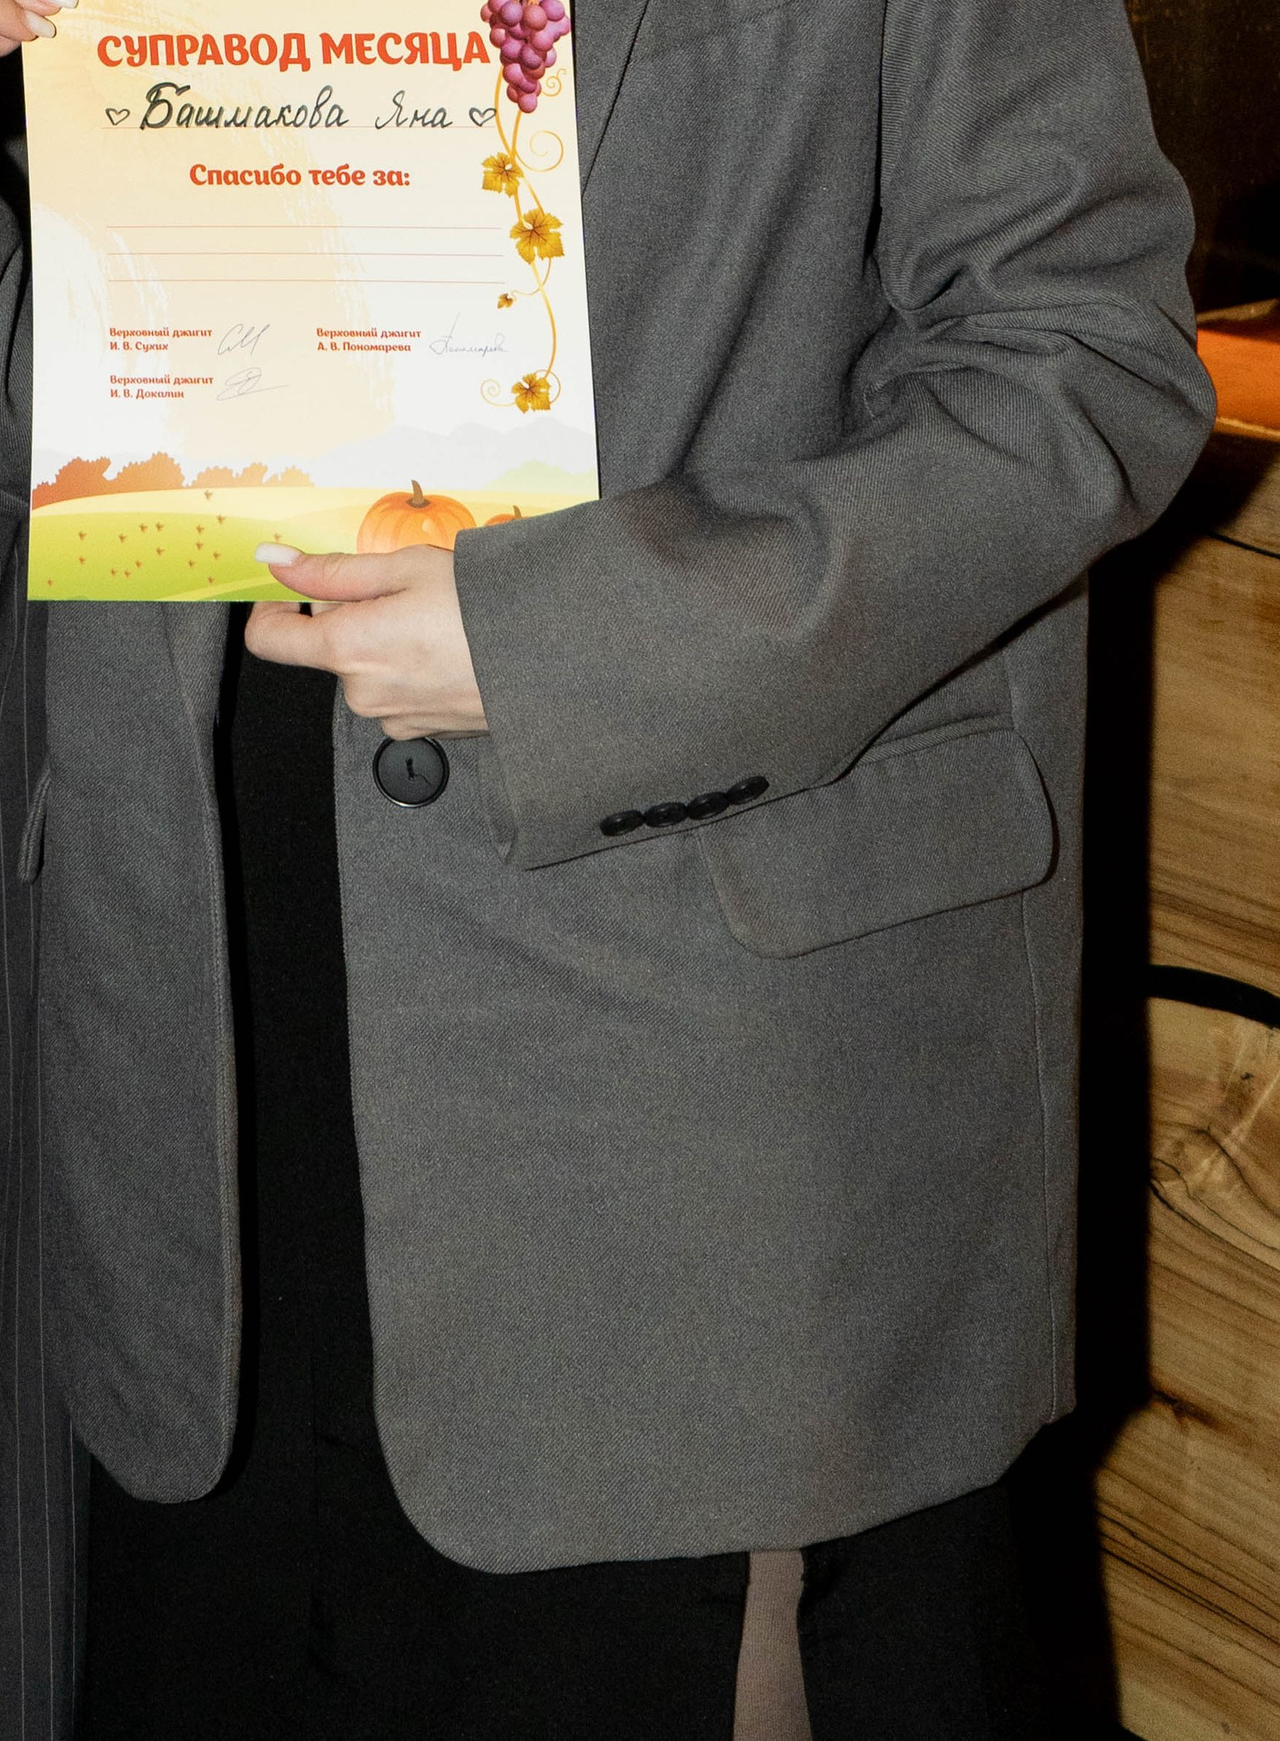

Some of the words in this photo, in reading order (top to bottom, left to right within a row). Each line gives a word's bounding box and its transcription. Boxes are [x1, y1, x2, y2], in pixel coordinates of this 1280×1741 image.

[97, 32, 312, 73] СУПРАВОД
[318, 31, 492, 72] МЕСЯЦА
[139, 81, 350, 130] Башмакова
[374, 90, 454, 130] Яна
[189, 163, 302, 187] Спасибо
[308, 163, 366, 187] тебе
[372, 169, 411, 187] за:
[109, 327, 170, 339] Верховный
[172, 329, 213, 339] джигит
[316, 327, 378, 340] Верховный
[380, 330, 422, 339] джигит
[109, 341, 120, 351] И.
[122, 341, 133, 351] В.
[135, 341, 169, 352] Сухих
[317, 342, 328, 351] А.
[330, 342, 340, 351] В.
[342, 342, 412, 353] Пономарева
[109, 375, 171, 386] Верховный
[173, 377, 214, 386] джигит
[110, 388, 121, 398] И.
[123, 388, 133, 398] В.
[136, 388, 185, 400] Докалин
